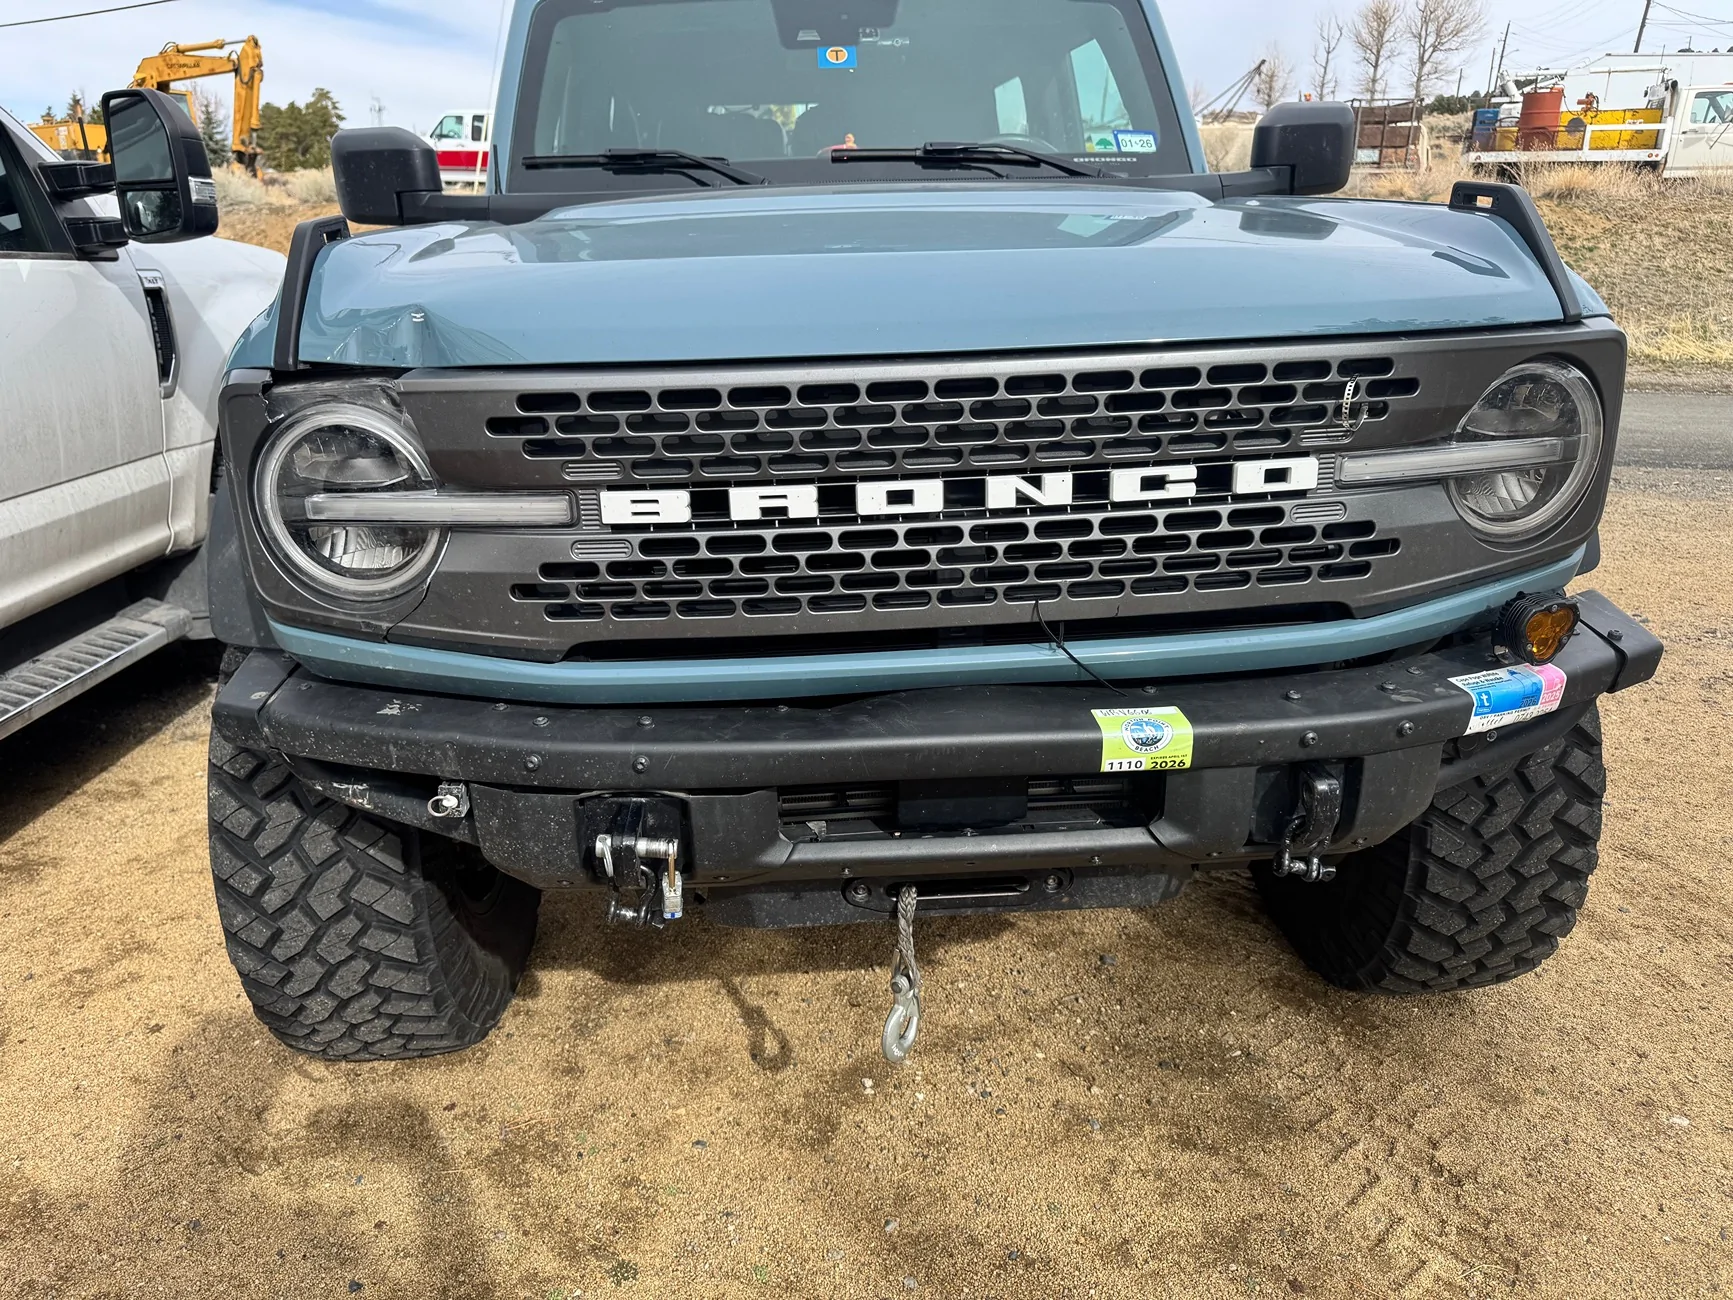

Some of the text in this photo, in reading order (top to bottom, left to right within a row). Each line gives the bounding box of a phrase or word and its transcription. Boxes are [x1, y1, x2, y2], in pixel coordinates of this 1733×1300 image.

[830, 49, 843, 61] T
[1120, 138, 1153, 148] 01 26
[599, 456, 1320, 525] BRONCO
[1541, 692, 1560, 703] 2025
[1107, 758, 1186, 770] 1110 2026
